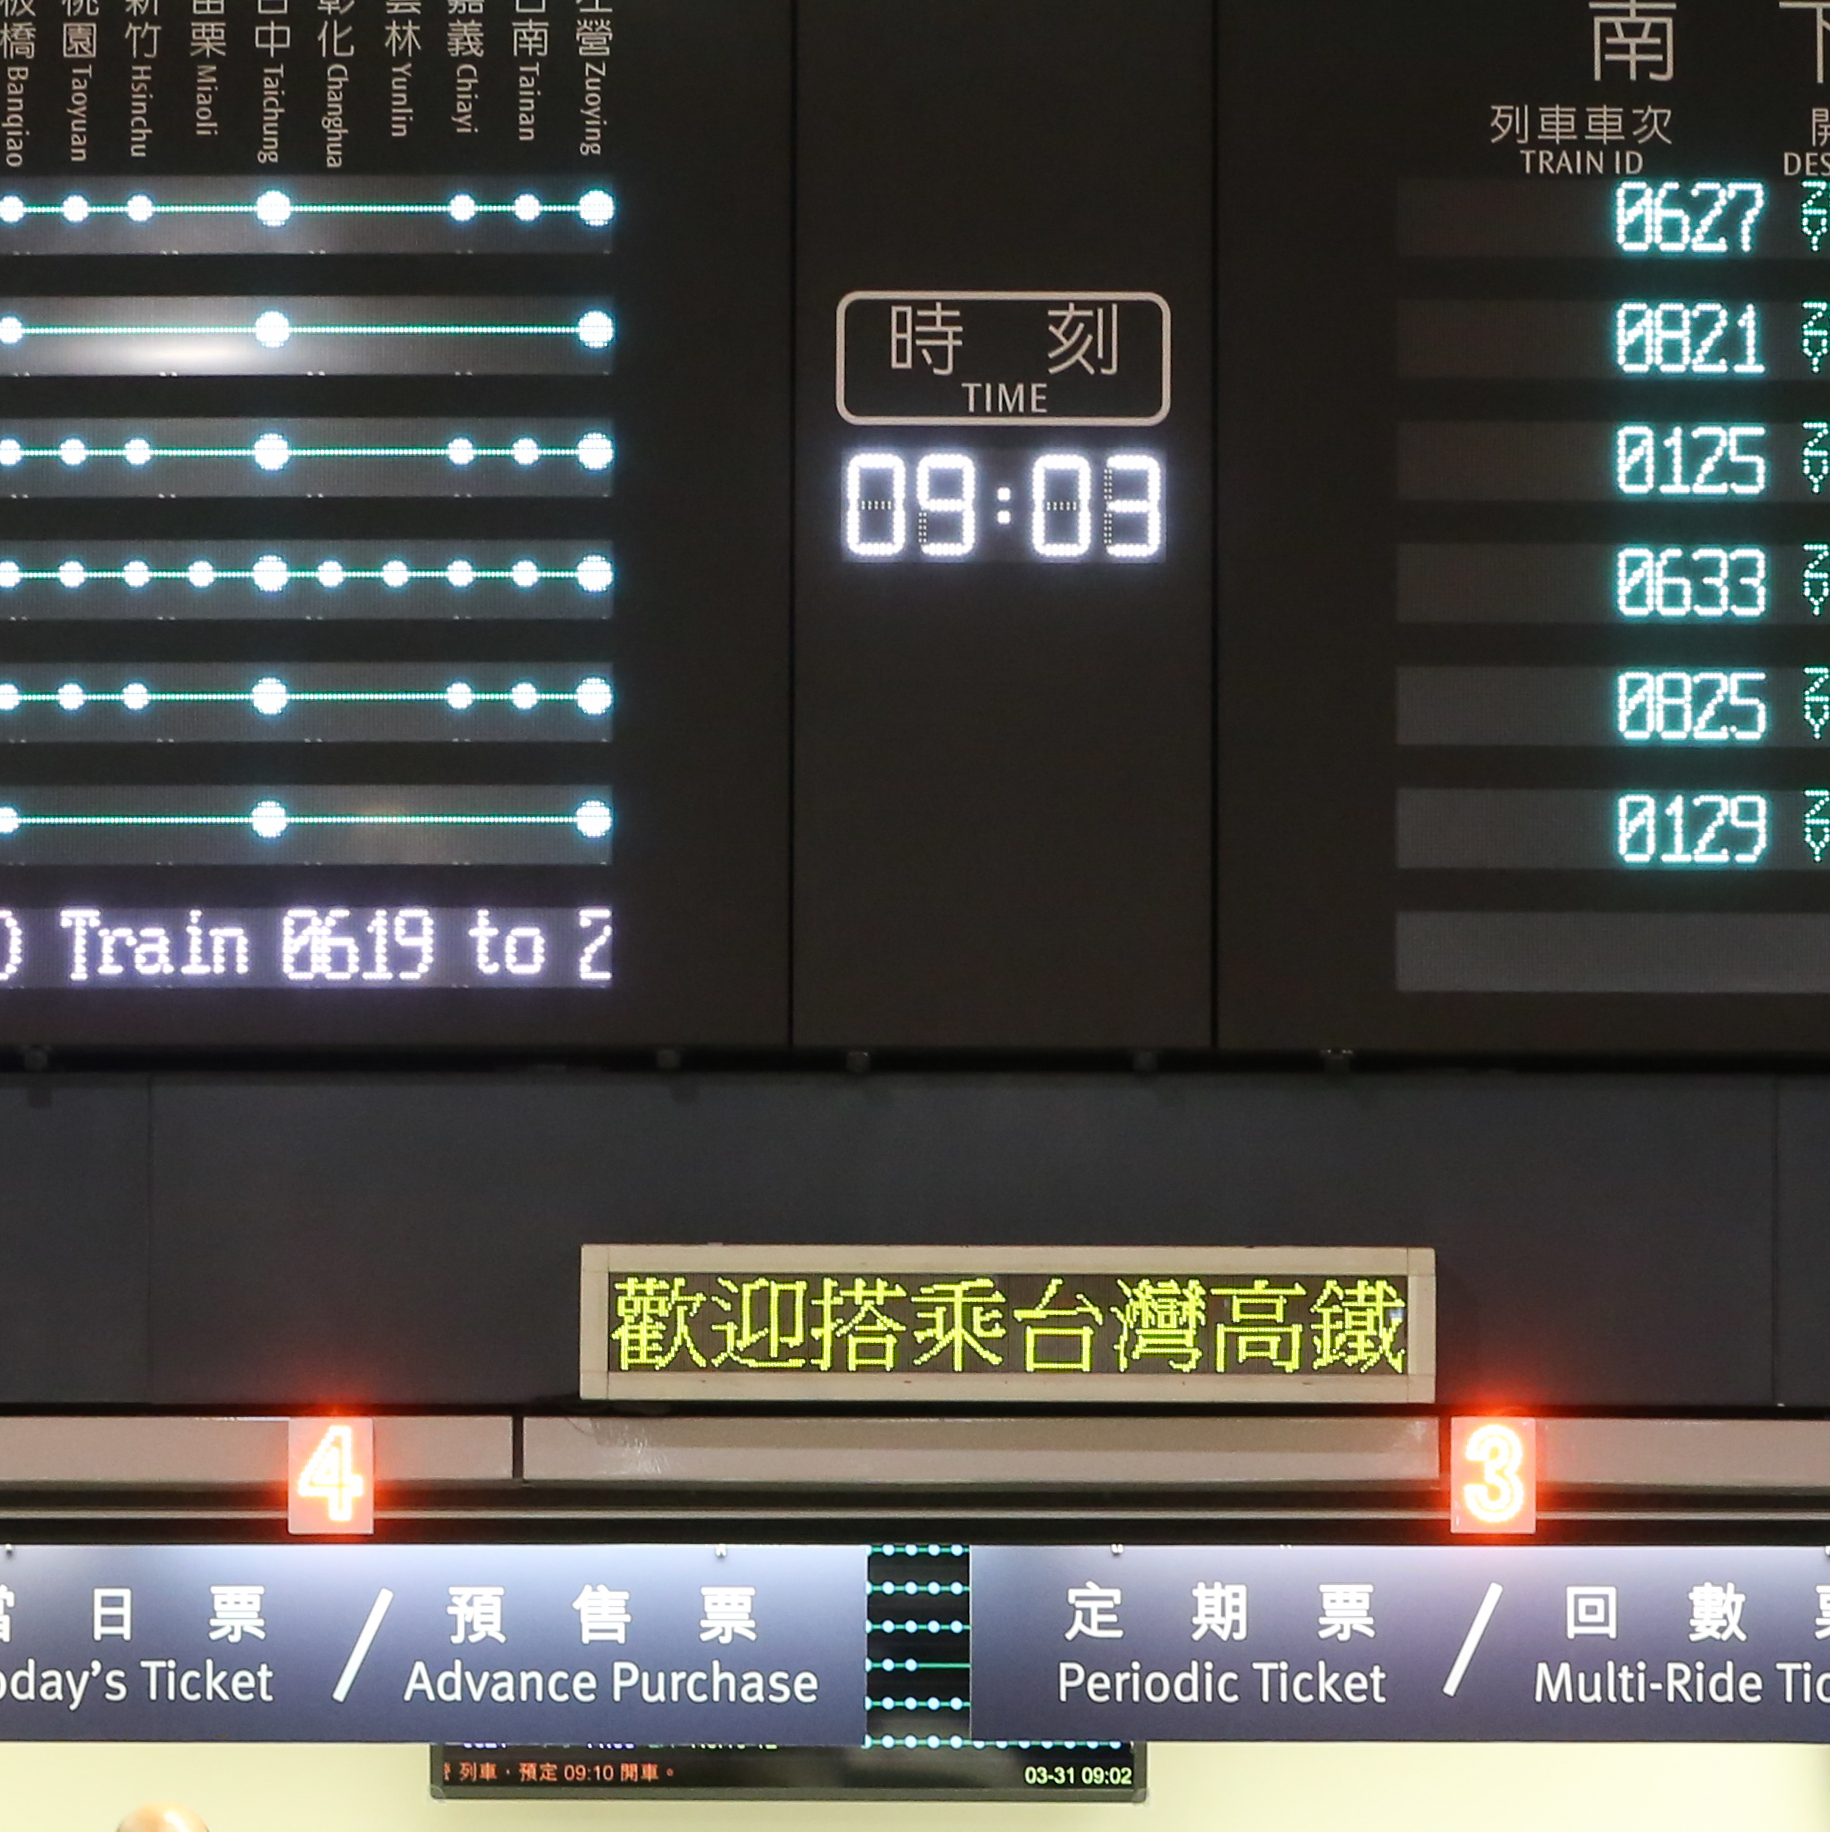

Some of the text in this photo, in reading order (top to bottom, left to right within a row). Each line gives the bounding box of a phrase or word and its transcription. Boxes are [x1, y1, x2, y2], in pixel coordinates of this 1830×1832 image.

[2, 67, 29, 167] Banqiao
[67, 65, 92, 161] Taoyuan
[131, 66, 153, 156] Hsinchu
[196, 66, 218, 135] Miaoli
[257, 64, 285, 163] Taichung
[322, 64, 349, 167] Changhua
[392, 63, 413, 136] Yunlin
[452, 64, 478, 132] Chiayi
[519, 62, 541, 140] Tainan
[580, 62, 607, 155] Zuoying
[1491, 104, 1671, 145] 列車車次
[1520, 150, 1642, 174] TRAIN ID
[1616, 182, 1764, 252] 0627
[891, 302, 1119, 375] 時刻
[1616, 302, 1764, 374] 0821
[962, 383, 1047, 412] TIME
[1617, 426, 1765, 495] 0125
[846, 450, 1161, 558] 09:03
[1617, 548, 1766, 617] 0633
[1618, 671, 1766, 740] 0825
[1618, 794, 1766, 864] 0129
[60, 909, 248, 981] Train
[282, 909, 434, 980] 0619
[468, 910, 545, 975] to
[609, 1275, 1409, 1374] 歡迎搭乘台灣高鐵
[297, 1425, 365, 1523] 4
[1462, 1423, 1525, 1523] 3
[445, 1582, 759, 1643] 預售票
[1066, 1581, 1374, 1640] 定期票
[141, 1659, 273, 1701] Ticket
[404, 1660, 817, 1702] Advance Purchase
[1060, 1661, 1385, 1702] Periodic Ticket
[1536, 1661, 1762, 1702] Multi-Ride
[564, 1765, 614, 1780] 09:10
[1025, 1767, 1131, 1784] 03-31 09:02
